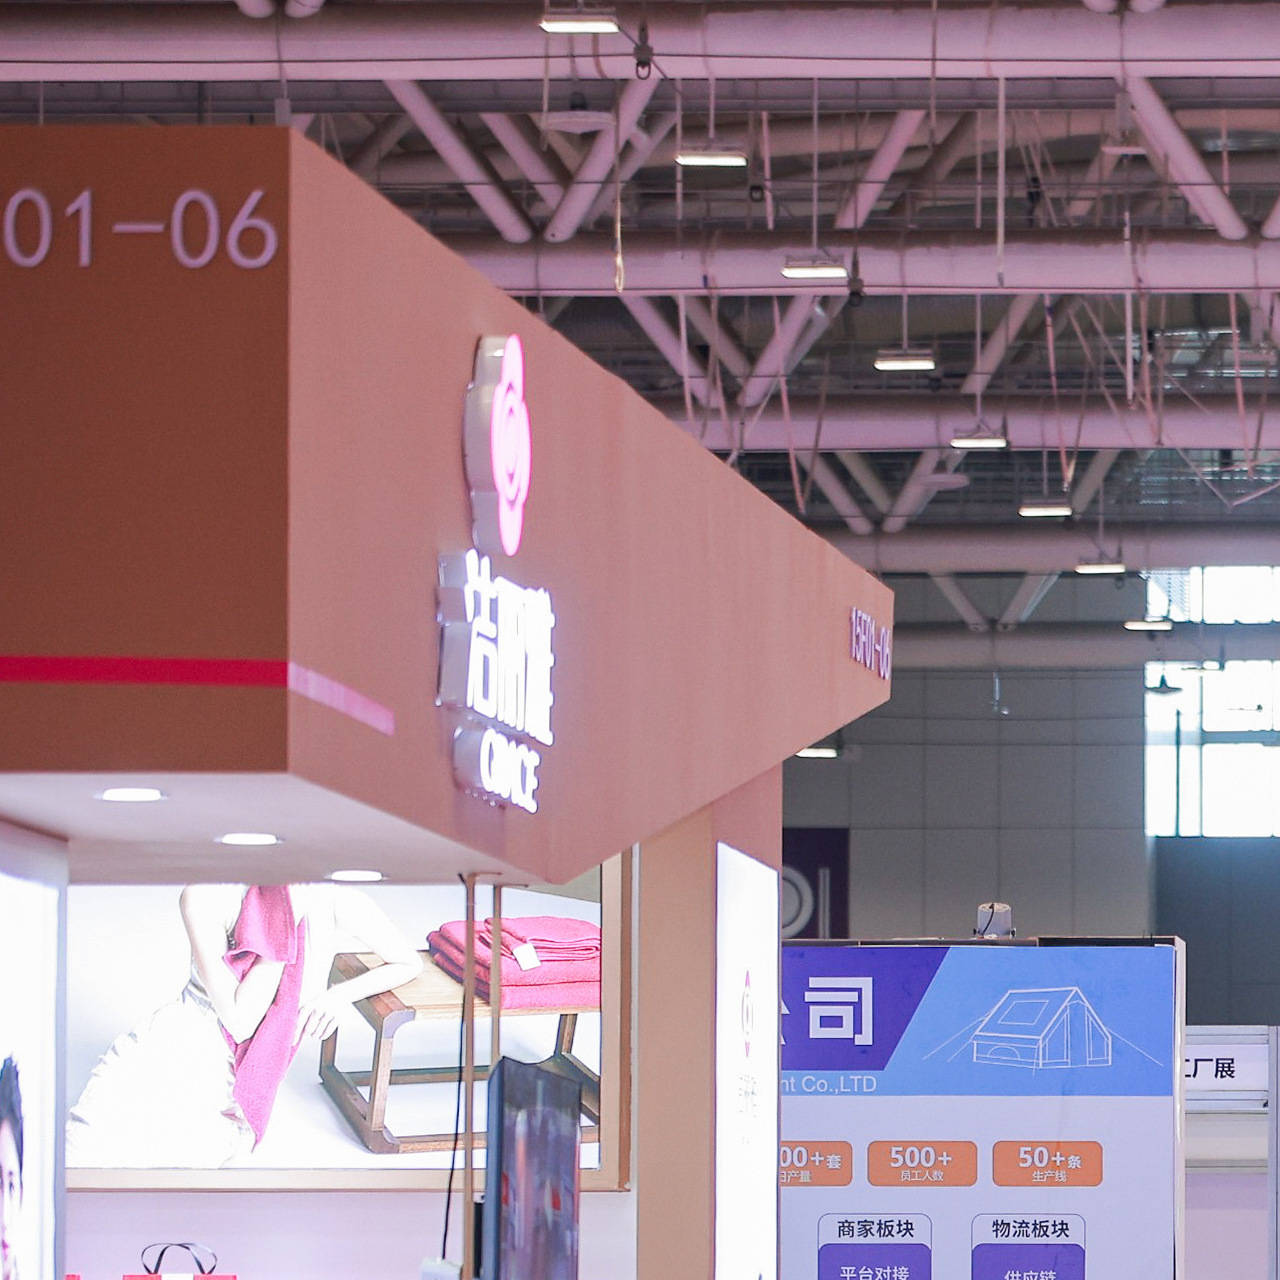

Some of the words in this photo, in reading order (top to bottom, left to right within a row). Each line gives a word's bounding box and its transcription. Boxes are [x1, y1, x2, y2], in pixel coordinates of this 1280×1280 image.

[3, 188, 279, 270] 01-06
[781, 977, 874, 1046] 司
[802, 1076, 877, 1095] Co.,LTD
[890, 1147, 953, 1168] 500+
[1019, 1147, 1082, 1169] 50+条
[900, 1170, 944, 1182] 员工人数
[1032, 1170, 1067, 1182] 生产线
[837, 1220, 915, 1239] 商家板块
[992, 1220, 1071, 1239] 物流板块
